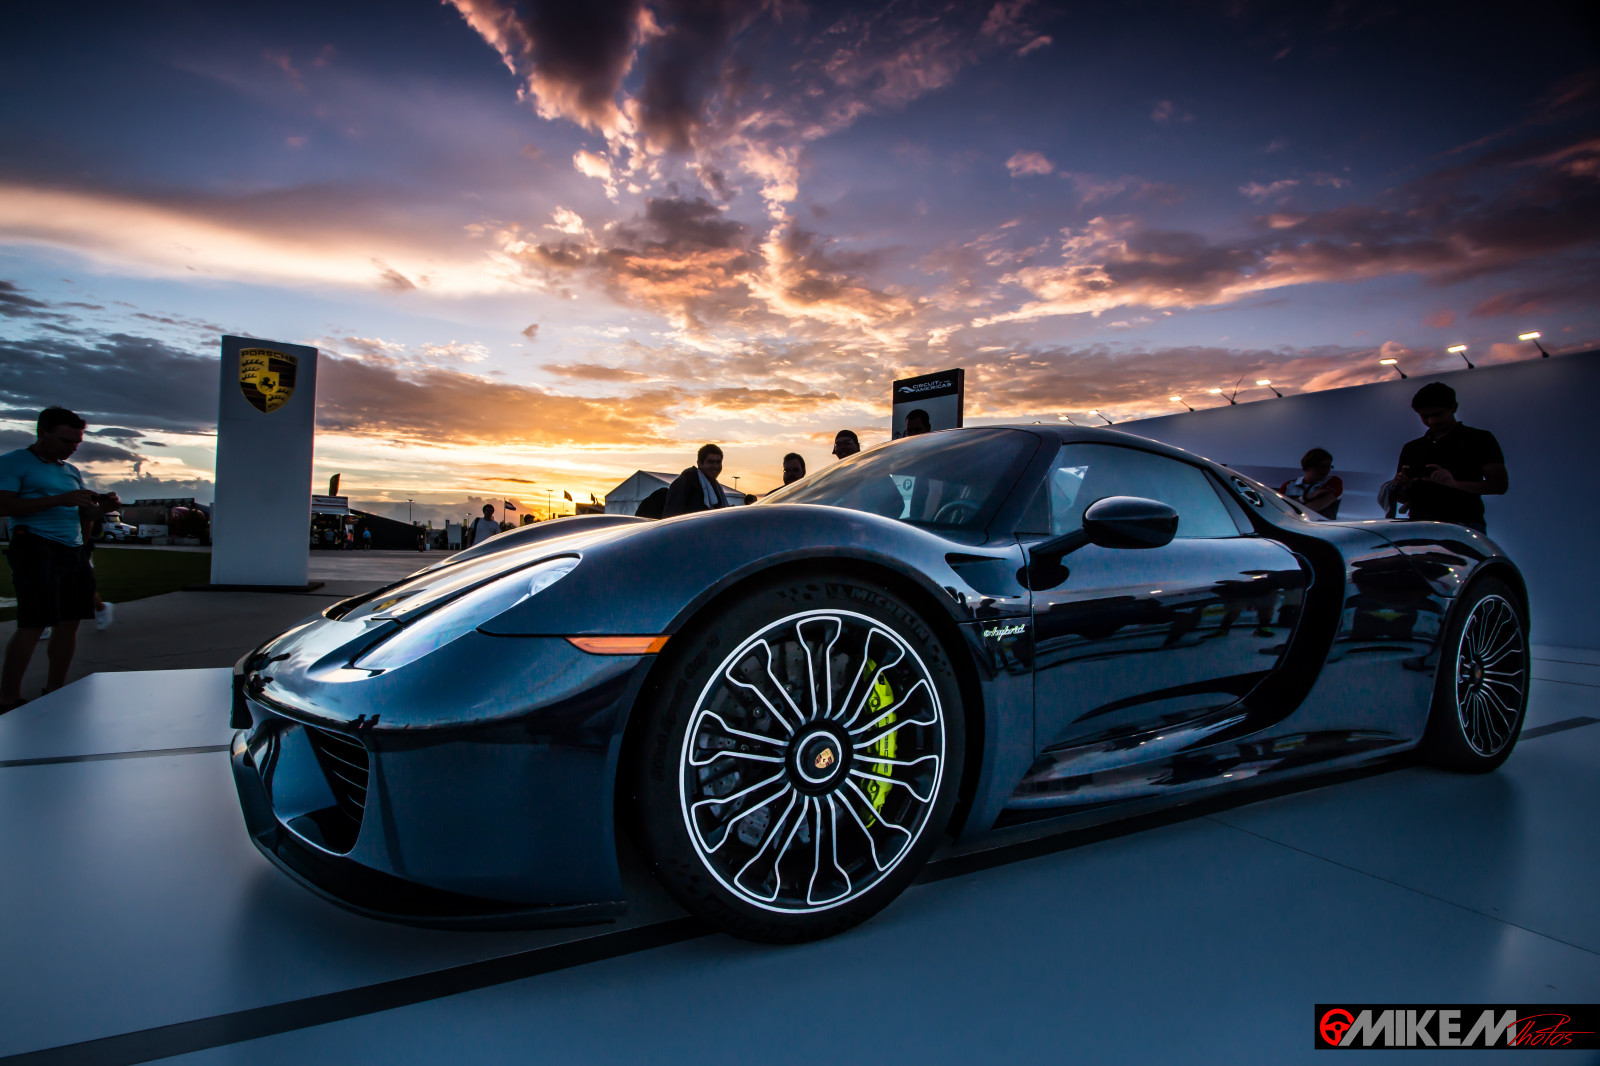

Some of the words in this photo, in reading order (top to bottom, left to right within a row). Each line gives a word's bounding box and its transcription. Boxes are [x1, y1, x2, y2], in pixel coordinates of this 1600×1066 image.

[241, 350, 296, 362] PORSCHE
[912, 380, 939, 389] CIRCUIT
[915, 382, 952, 392] AMERICAS
[850, 587, 929, 640] MICHELIN
